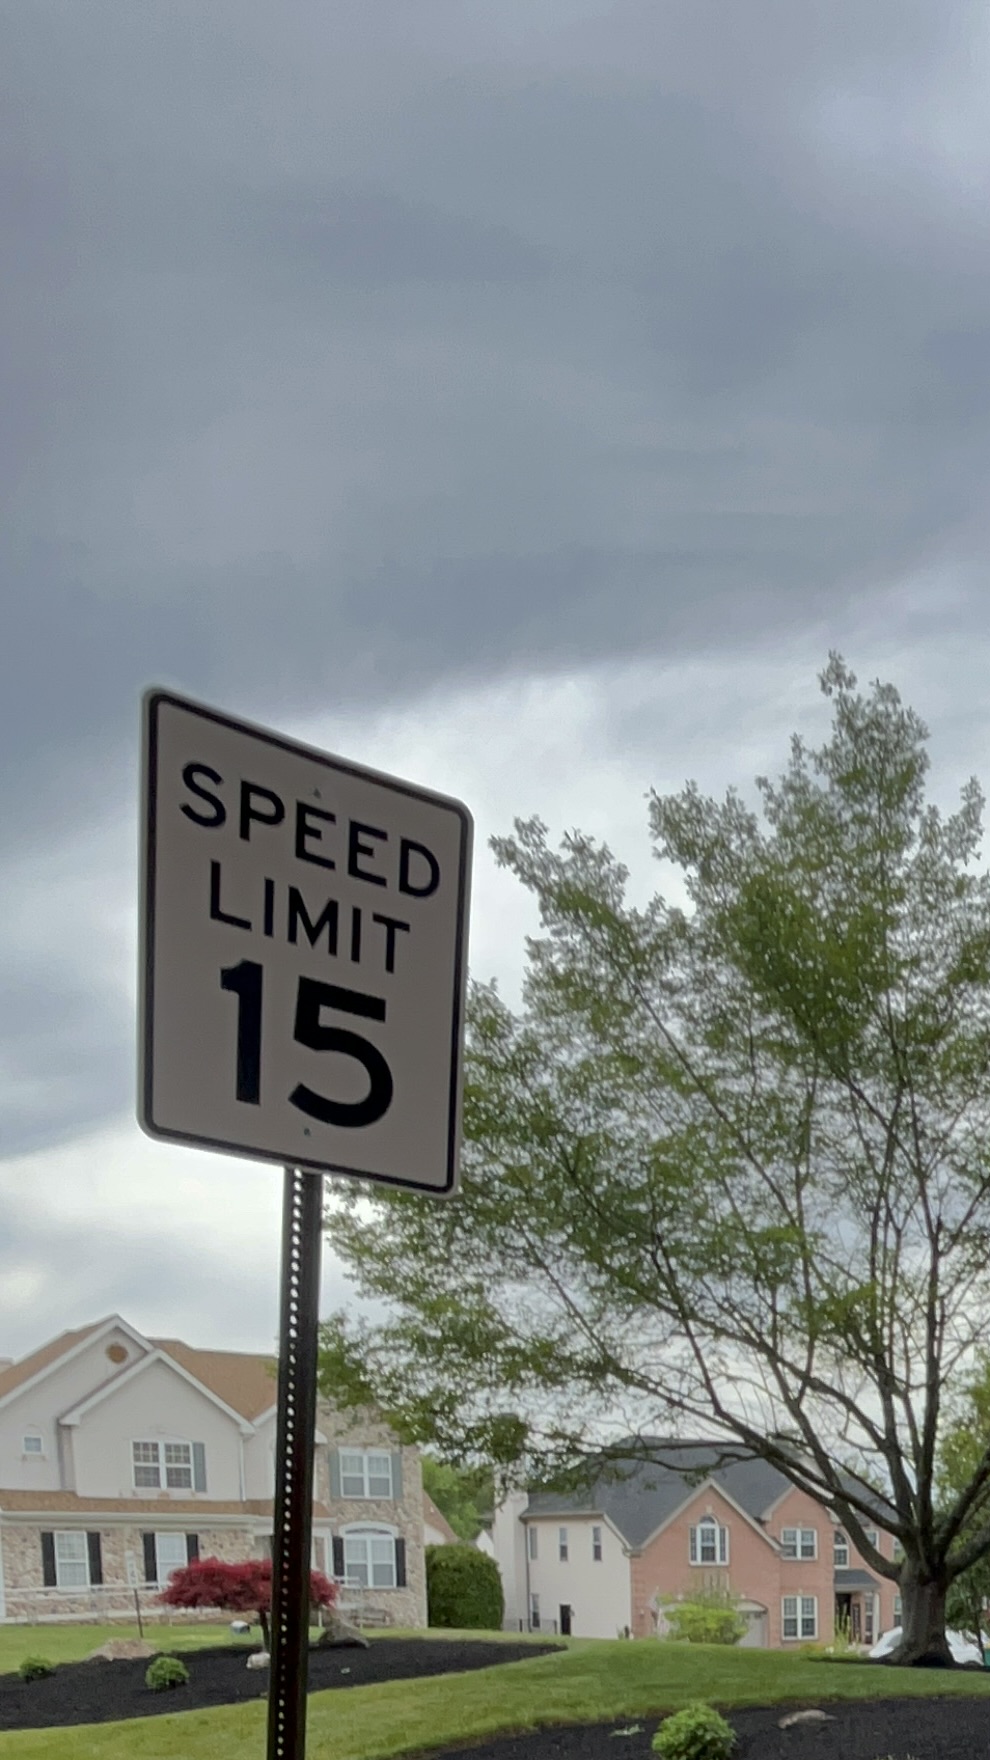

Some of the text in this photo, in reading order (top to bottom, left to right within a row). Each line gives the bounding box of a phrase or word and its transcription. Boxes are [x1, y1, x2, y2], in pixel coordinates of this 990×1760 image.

[179, 761, 441, 899] SPEED
[209, 859, 411, 975] LIMIT
[220, 959, 394, 1129] 15
